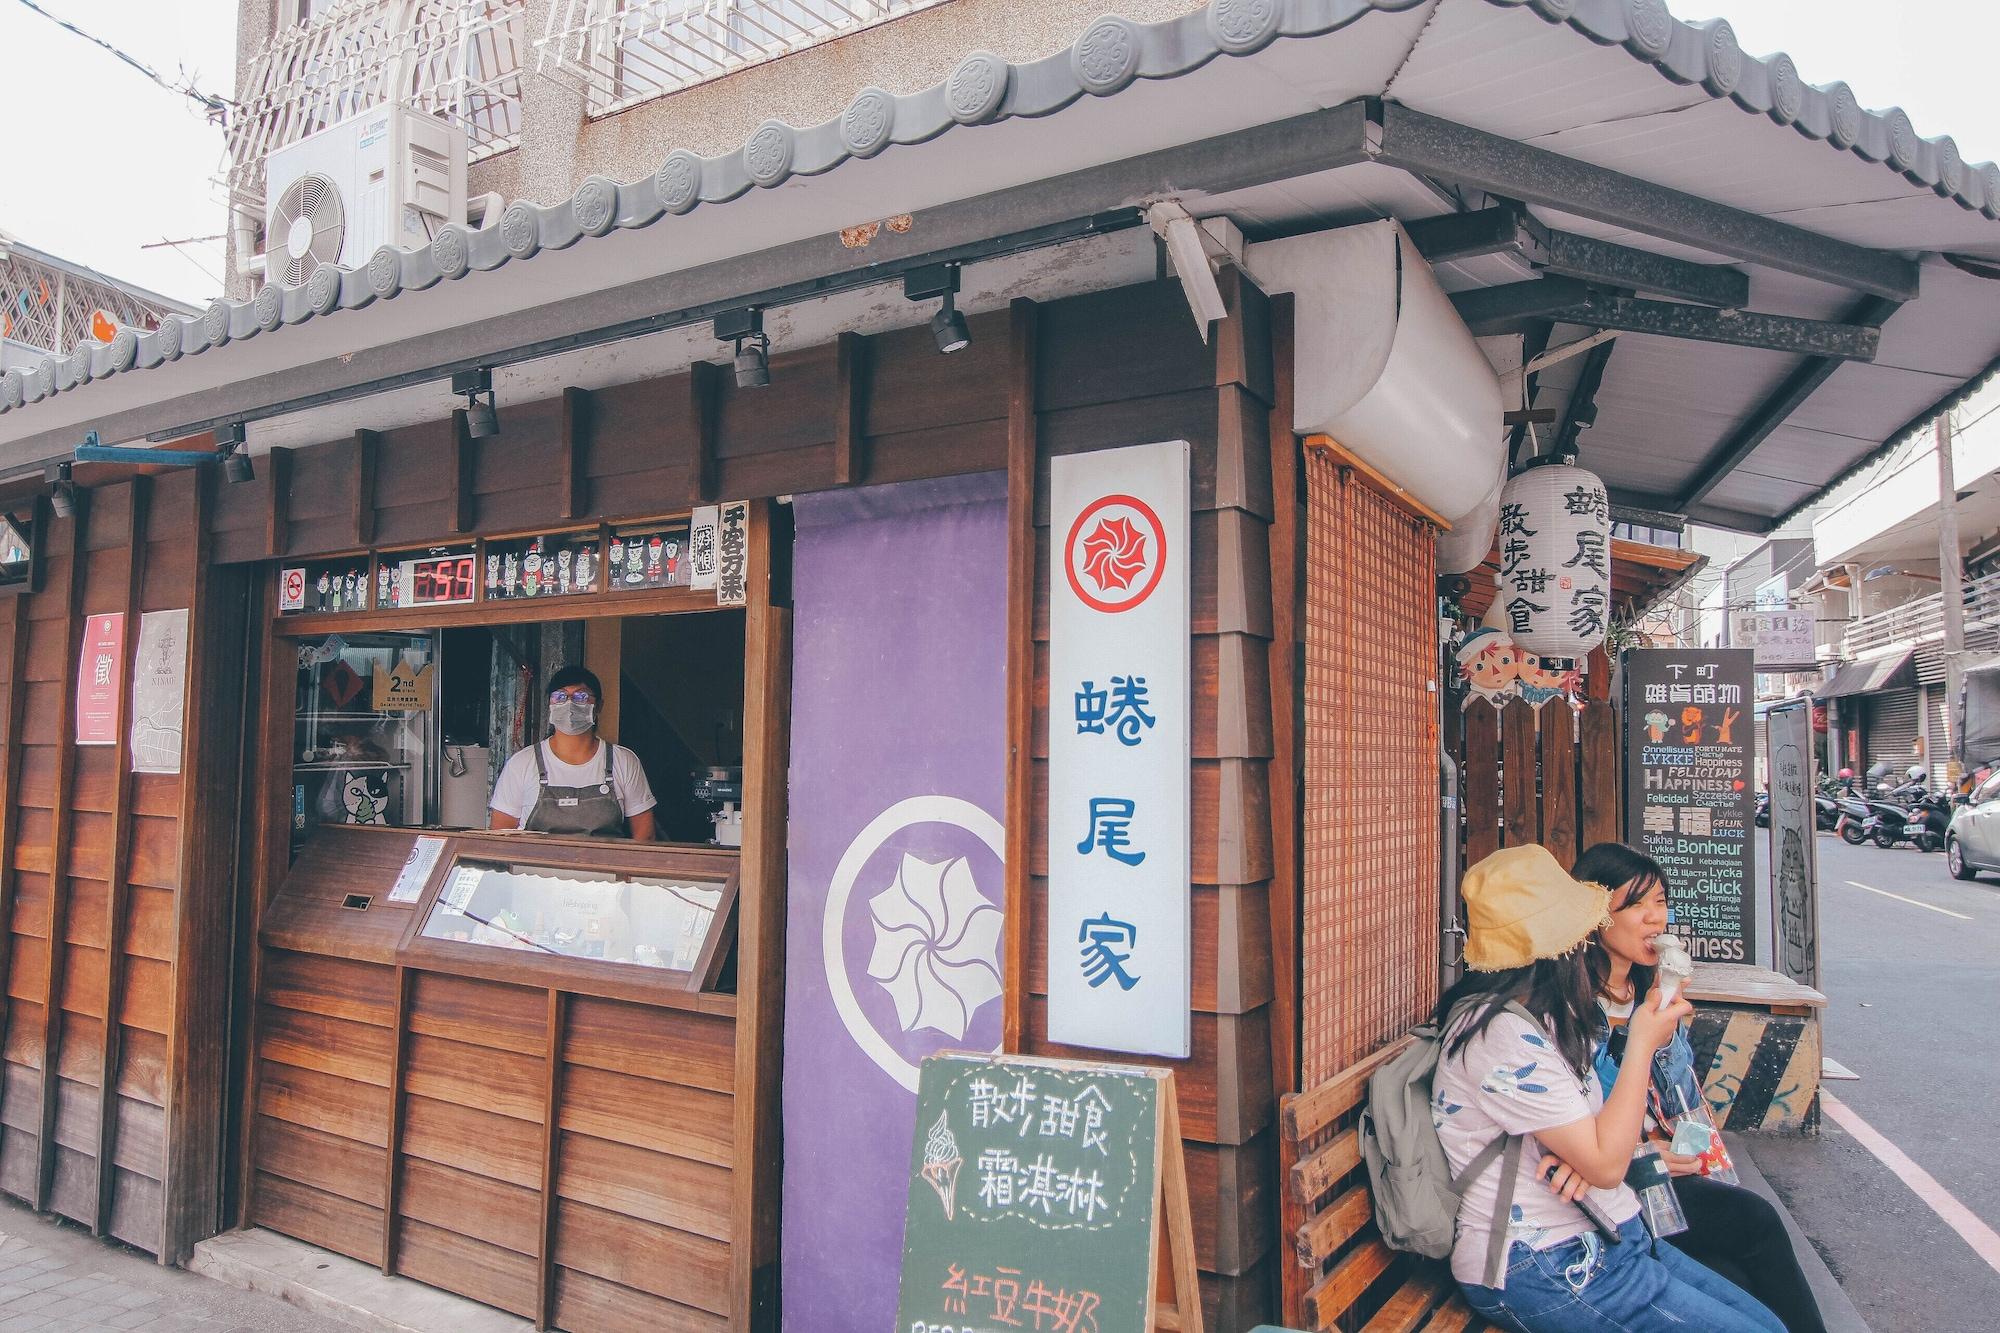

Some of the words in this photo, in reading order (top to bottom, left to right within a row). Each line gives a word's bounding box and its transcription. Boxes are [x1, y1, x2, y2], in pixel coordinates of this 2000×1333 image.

[1561, 485, 1609, 638] 蜷尾家
[1666, 664, 1719, 680] 下町
[391, 676, 414, 692] 2nd
[1645, 684, 1741, 704] 雜貨萌物
[1643, 745, 1694, 754] Onnellisuus
[1642, 753, 1694, 766] LYKKE
[1695, 757, 1743, 768] Happiness
[1668, 767, 1742, 778] FELICIDAD
[1647, 793, 1689, 804] Felicidad
[1692, 790, 1741, 802] Szczęście
[1696, 799, 1735, 808] Счастье
[1717, 809, 1743, 818] Lykke
[1643, 805, 1712, 837] 幸福
[1074, 675, 1156, 992] 蜷尾家
[1713, 829, 1745, 838] LUCK
[1643, 835, 1673, 845] Sukha
[1650, 845, 1675, 855] Lykke
[1677, 840, 1743, 856] Bonheur
[1710, 867, 1743, 879] Lycka
[1696, 879, 1743, 895] Glück
[1706, 894, 1741, 904] Hamingja
[1691, 918, 1741, 930] Felicidade
[1698, 929, 1742, 938] Onnellisuus
[1680, 936, 1744, 960] piness
[977, 1148, 1109, 1222] 霜淇淋
[942, 1263, 1102, 1333] 紅豆牛奶
